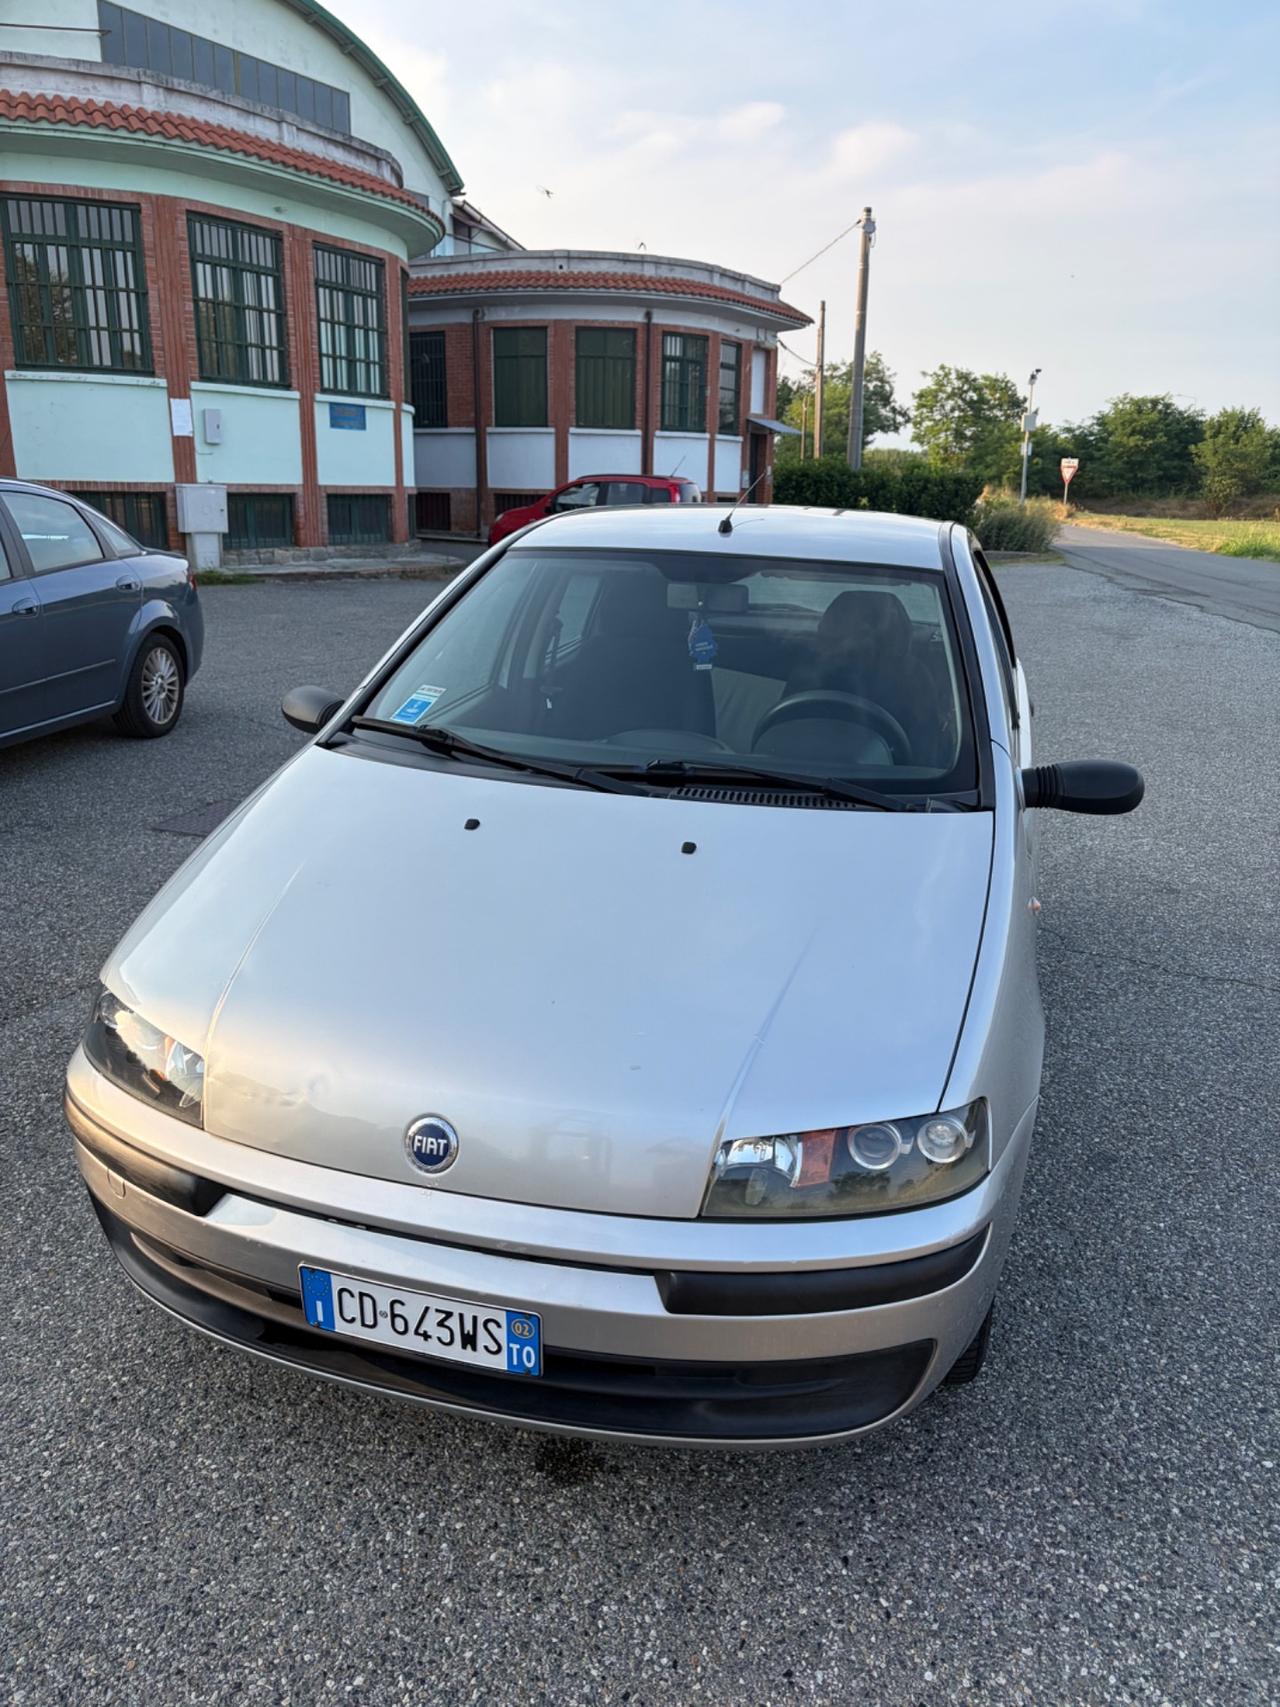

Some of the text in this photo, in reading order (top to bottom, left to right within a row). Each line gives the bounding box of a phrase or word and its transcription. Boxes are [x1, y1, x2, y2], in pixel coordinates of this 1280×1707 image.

[413, 1135, 448, 1156] FIAT
[513, 1323, 530, 1336] 02
[508, 1343, 536, 1369] TO
